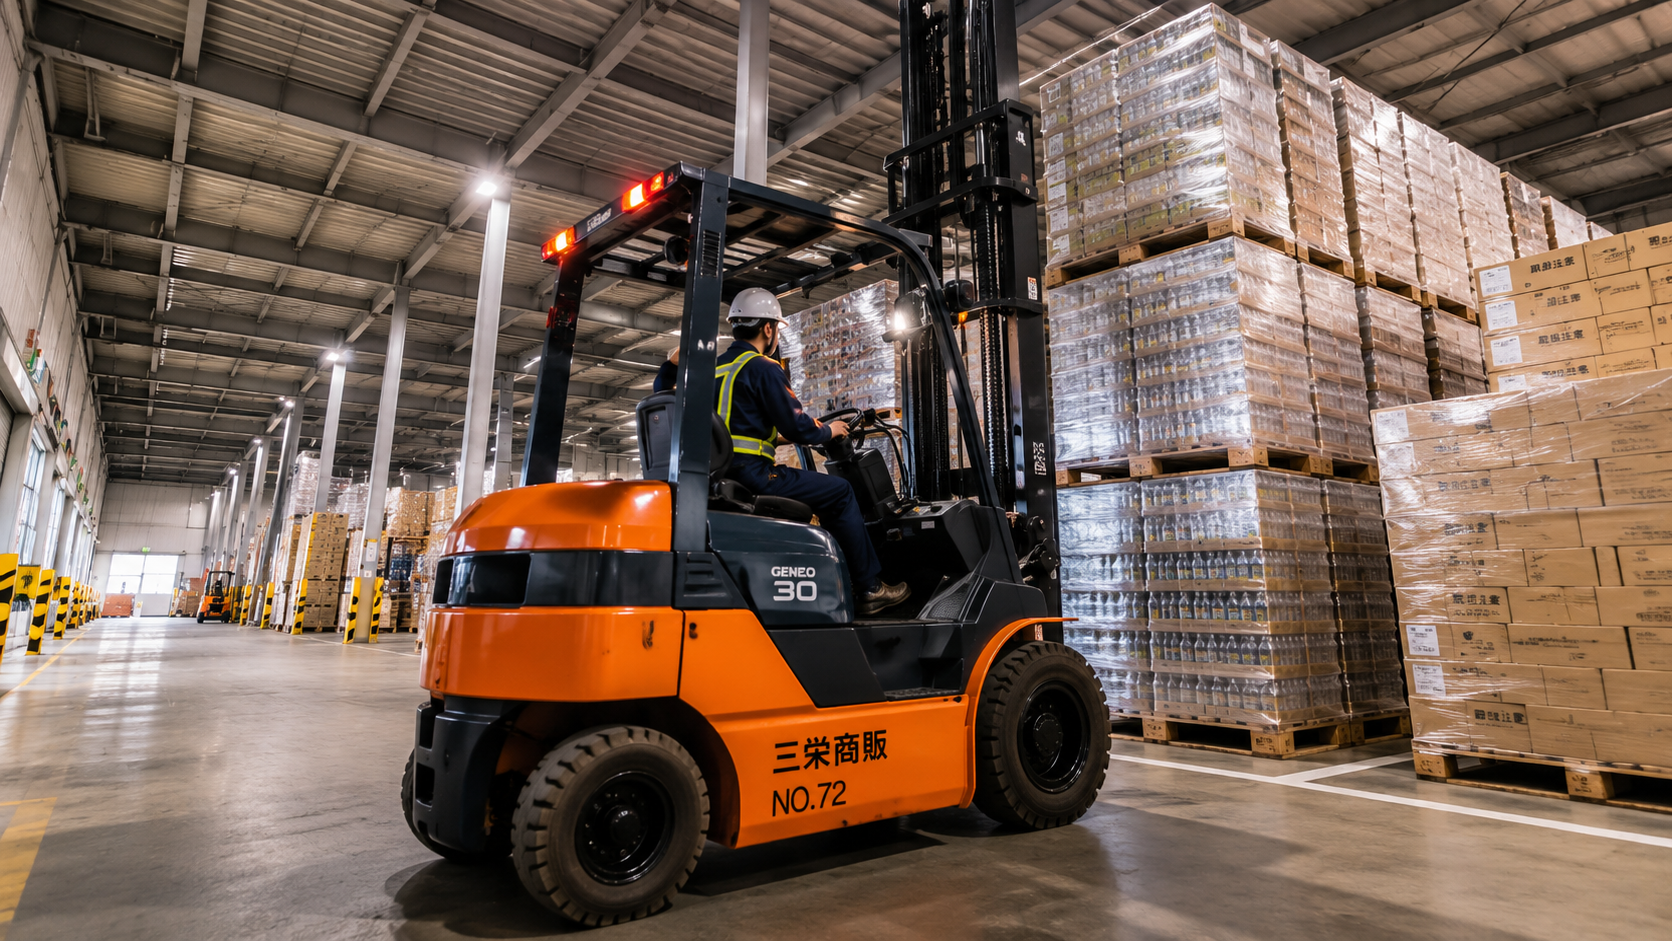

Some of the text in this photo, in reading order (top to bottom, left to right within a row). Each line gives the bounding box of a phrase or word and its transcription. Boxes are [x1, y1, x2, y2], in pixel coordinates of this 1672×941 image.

[771, 566, 816, 578] GENEO
[773, 580, 818, 602] 30
[773, 729, 888, 774] 三栄商販
[772, 780, 847, 817] NO.72
